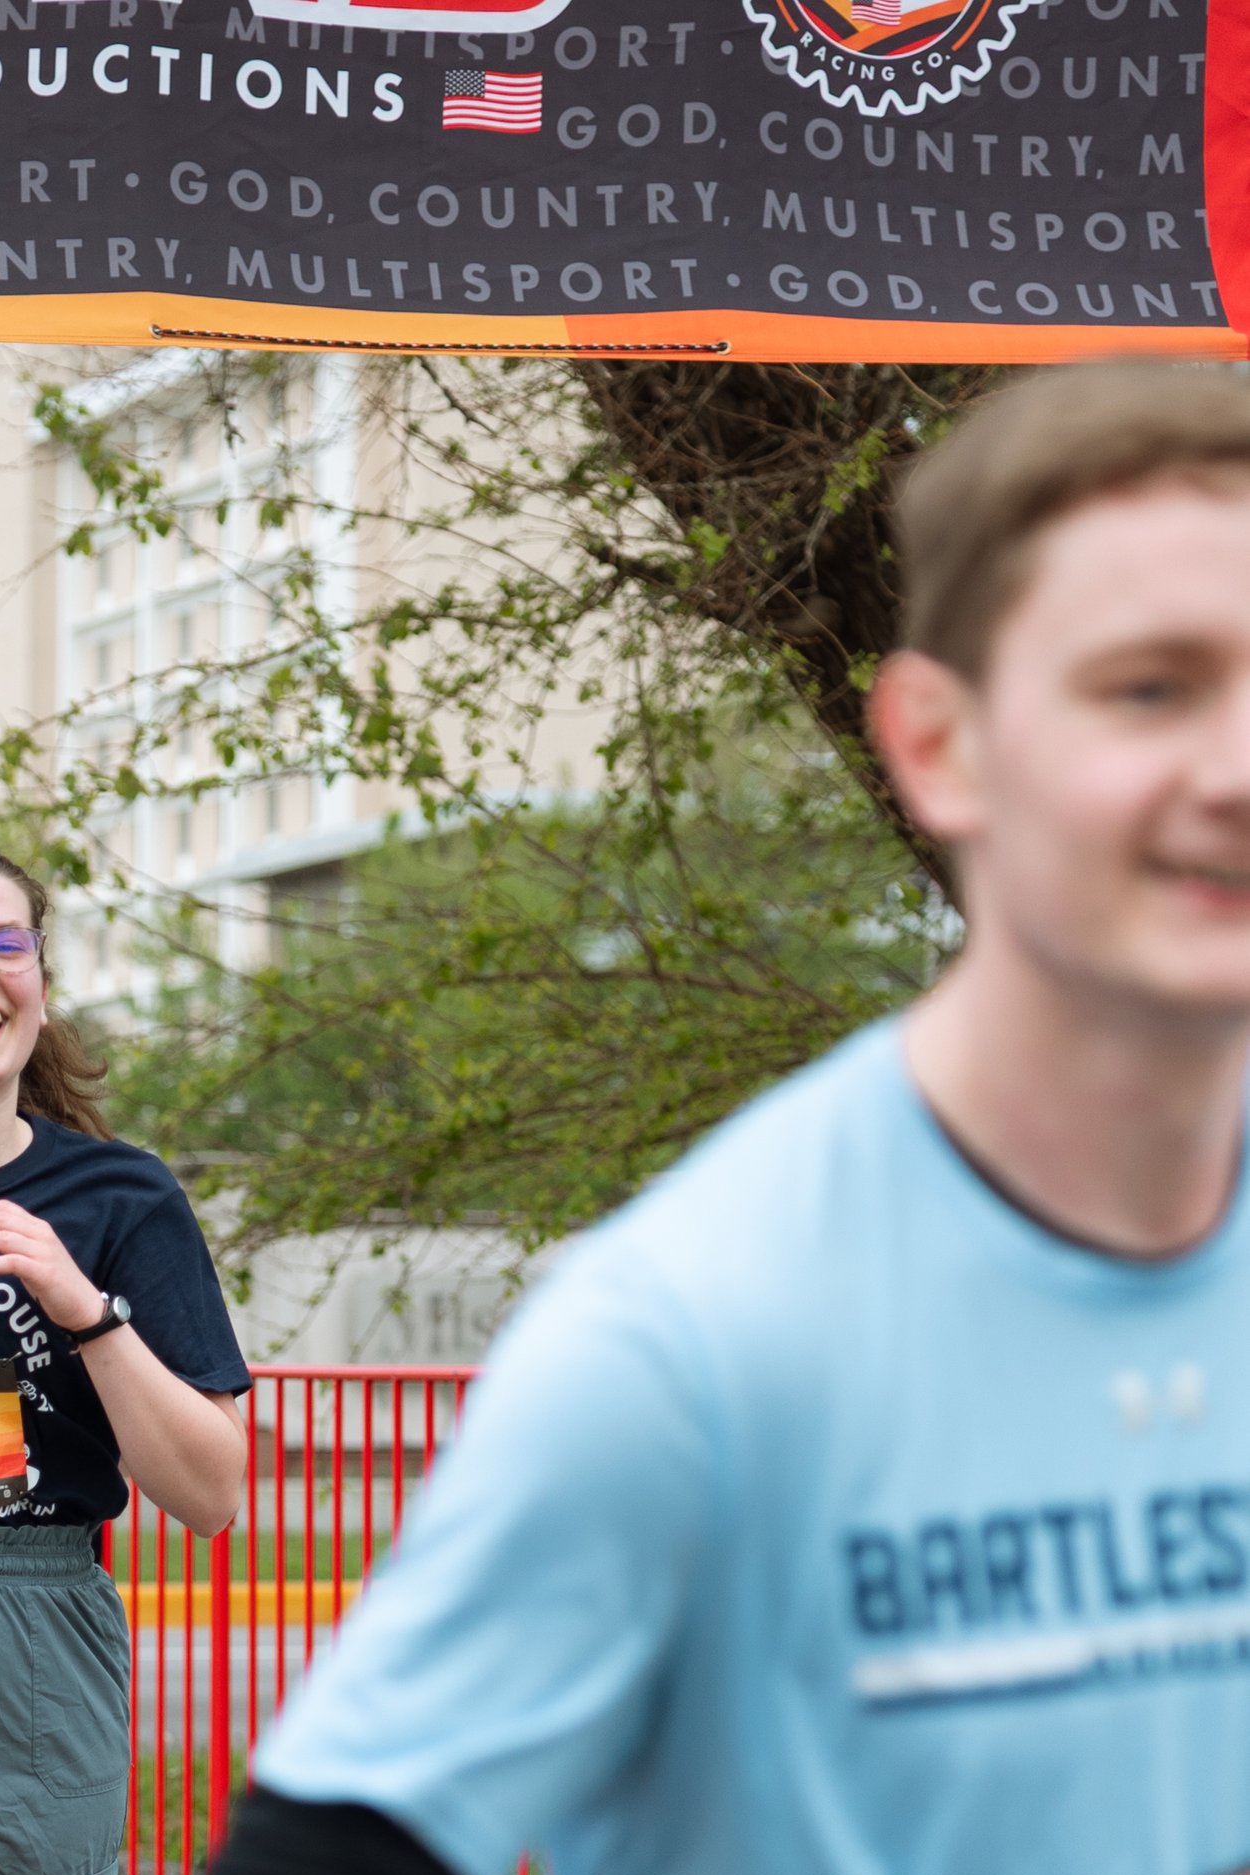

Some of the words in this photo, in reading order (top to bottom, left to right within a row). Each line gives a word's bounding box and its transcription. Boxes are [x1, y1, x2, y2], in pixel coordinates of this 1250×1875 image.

[800, 31, 896, 82] RACING
[911, 52, 951, 76] CO.
[556, 102, 726, 149] GOD,
[759, 112, 1103, 179] COUNTRY,
[170, 162, 335, 223] GOD,
[370, 182, 731, 228] COUNTRY,
[227, 247, 697, 302] MULTISPORT
[769, 264, 938, 314] GOD,
[968, 280, 1217, 318] COUNT
[846, 1483, 1250, 1642] BARTLES
